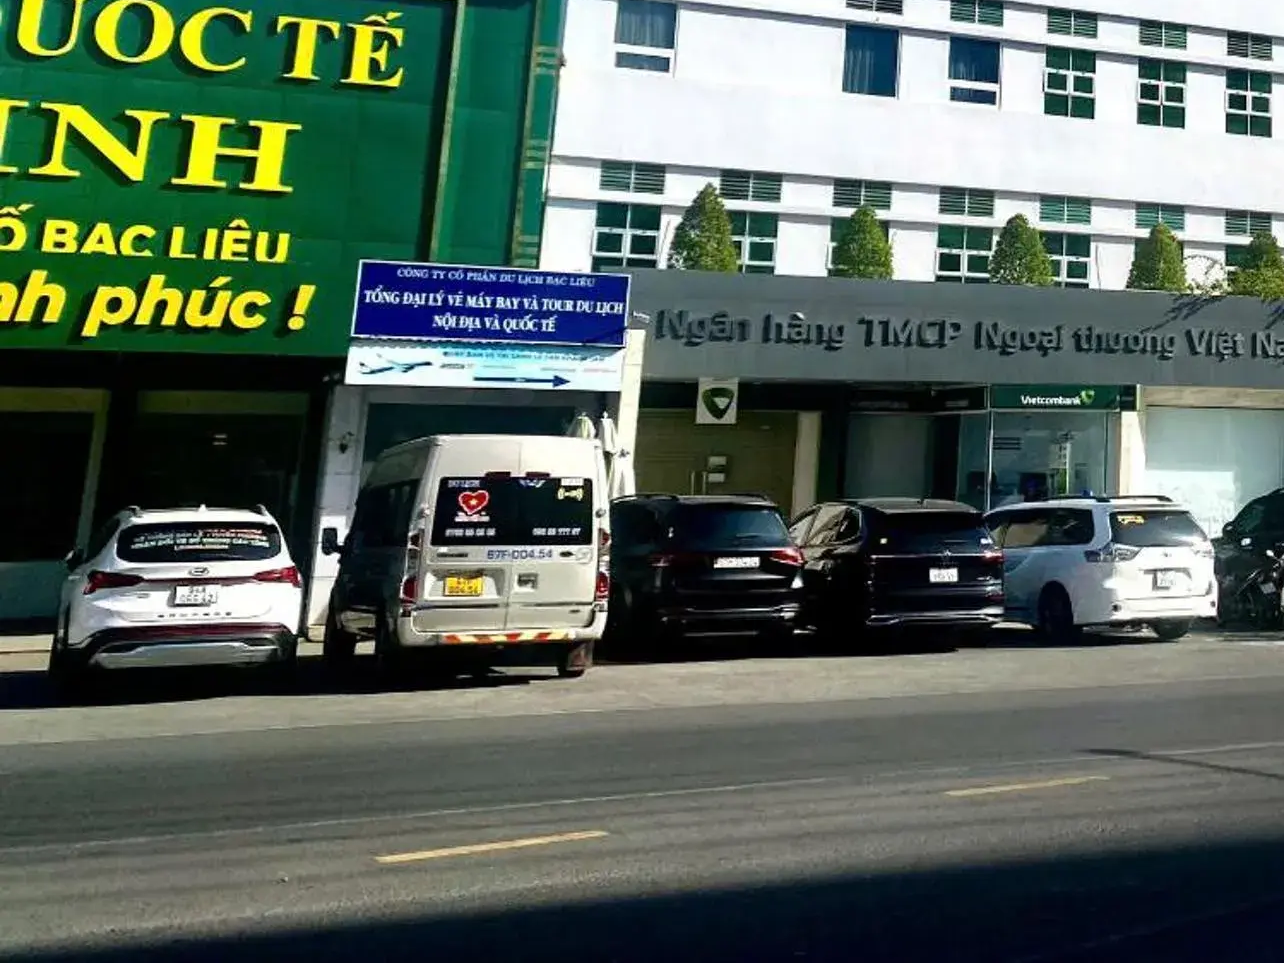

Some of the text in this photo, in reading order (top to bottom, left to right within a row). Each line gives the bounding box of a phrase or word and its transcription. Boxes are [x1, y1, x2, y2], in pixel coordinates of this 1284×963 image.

[277, 12, 405, 89] TẾ
[169, 219, 290, 264] LIÊU
[397, 267, 429, 278] CÔNG
[431, 269, 446, 279] TY
[499, 274, 516, 283] DU
[82, 274, 268, 337] phúc
[287, 284, 316, 330] !
[364, 285, 624, 316] TỔNG ĐẠI LÝ VÉ MÁY BAY VÀ TOUR DU LỊCH
[432, 312, 558, 334] NỘI ĐỊA VÀ QUỐC TẾ
[655, 309, 751, 347] Ngân
[762, 311, 845, 352] hàng
[857, 314, 961, 349] TMCP
[974, 321, 1064, 356] Ngoại
[1072, 325, 1176, 361] thương
[1186, 328, 1245, 362] Việt
[1020, 394, 1082, 406] Vietcombank
